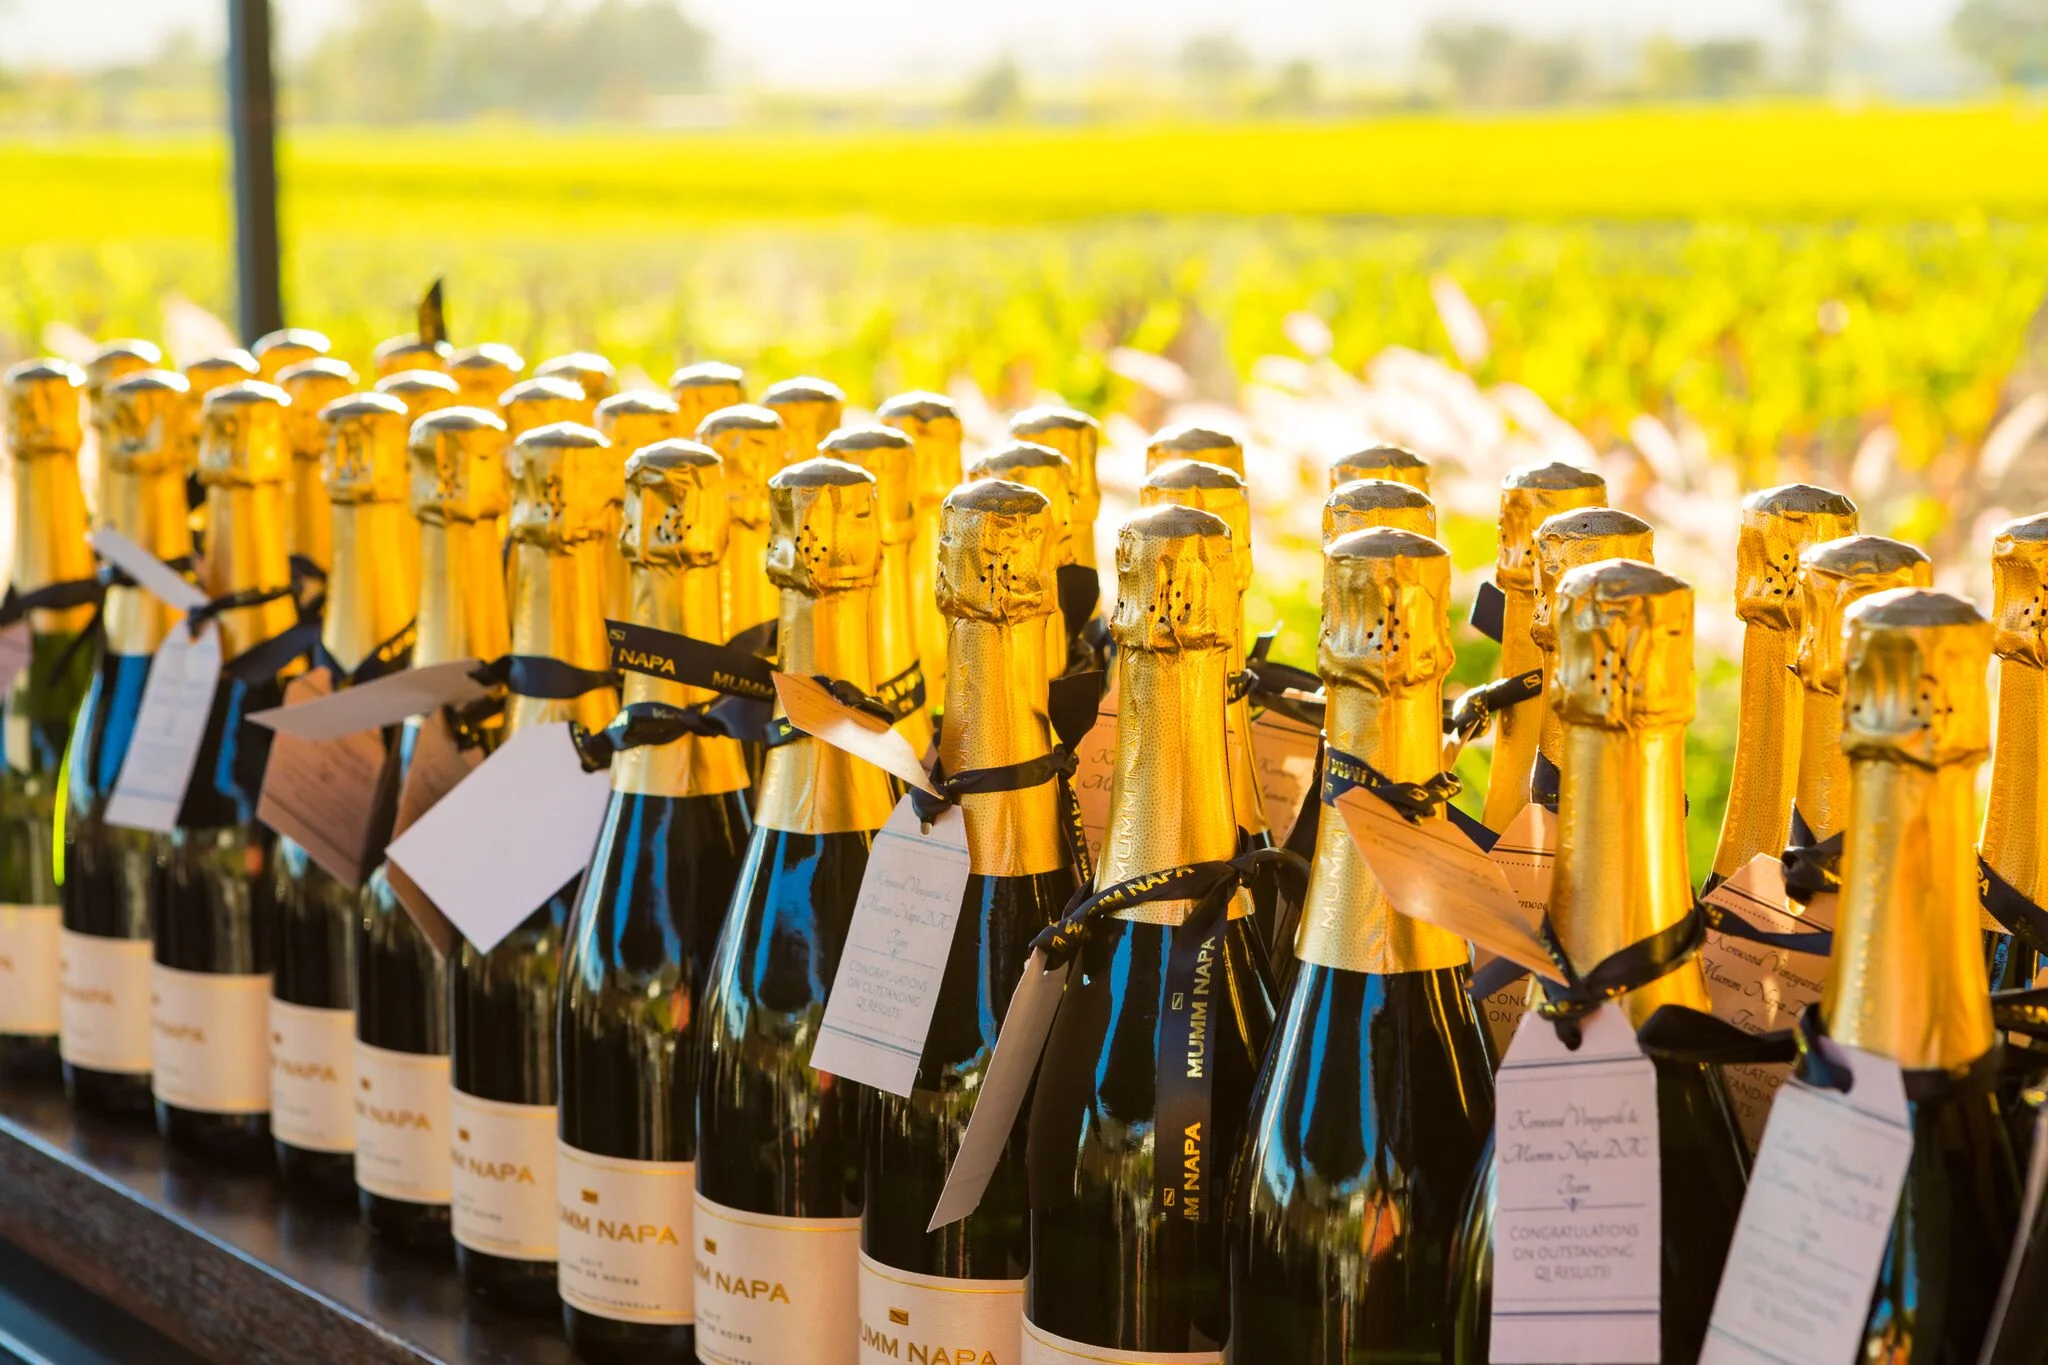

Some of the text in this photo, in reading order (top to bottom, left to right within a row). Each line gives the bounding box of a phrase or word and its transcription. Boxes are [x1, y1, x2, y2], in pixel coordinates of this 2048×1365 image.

[618, 648, 676, 675] NAPA
[1113, 789, 1137, 884] MUMM
[1320, 829, 1348, 929] MUMM
[846, 976, 921, 1009] ON OUTSTANDING
[1187, 935, 1217, 1079] MUMM NAPA
[1488, 1009, 1512, 1024] ON
[468, 1156, 535, 1185] NAPA
[1184, 1121, 1201, 1191] NAPA
[597, 1217, 679, 1246] NAPA
[1509, 1221, 1640, 1241] CONGRATULATIONS
[1512, 1243, 1635, 1262] ON OUTSTANDING
[714, 1270, 791, 1305] NAPA
[907, 1342, 998, 1365] NAPA
